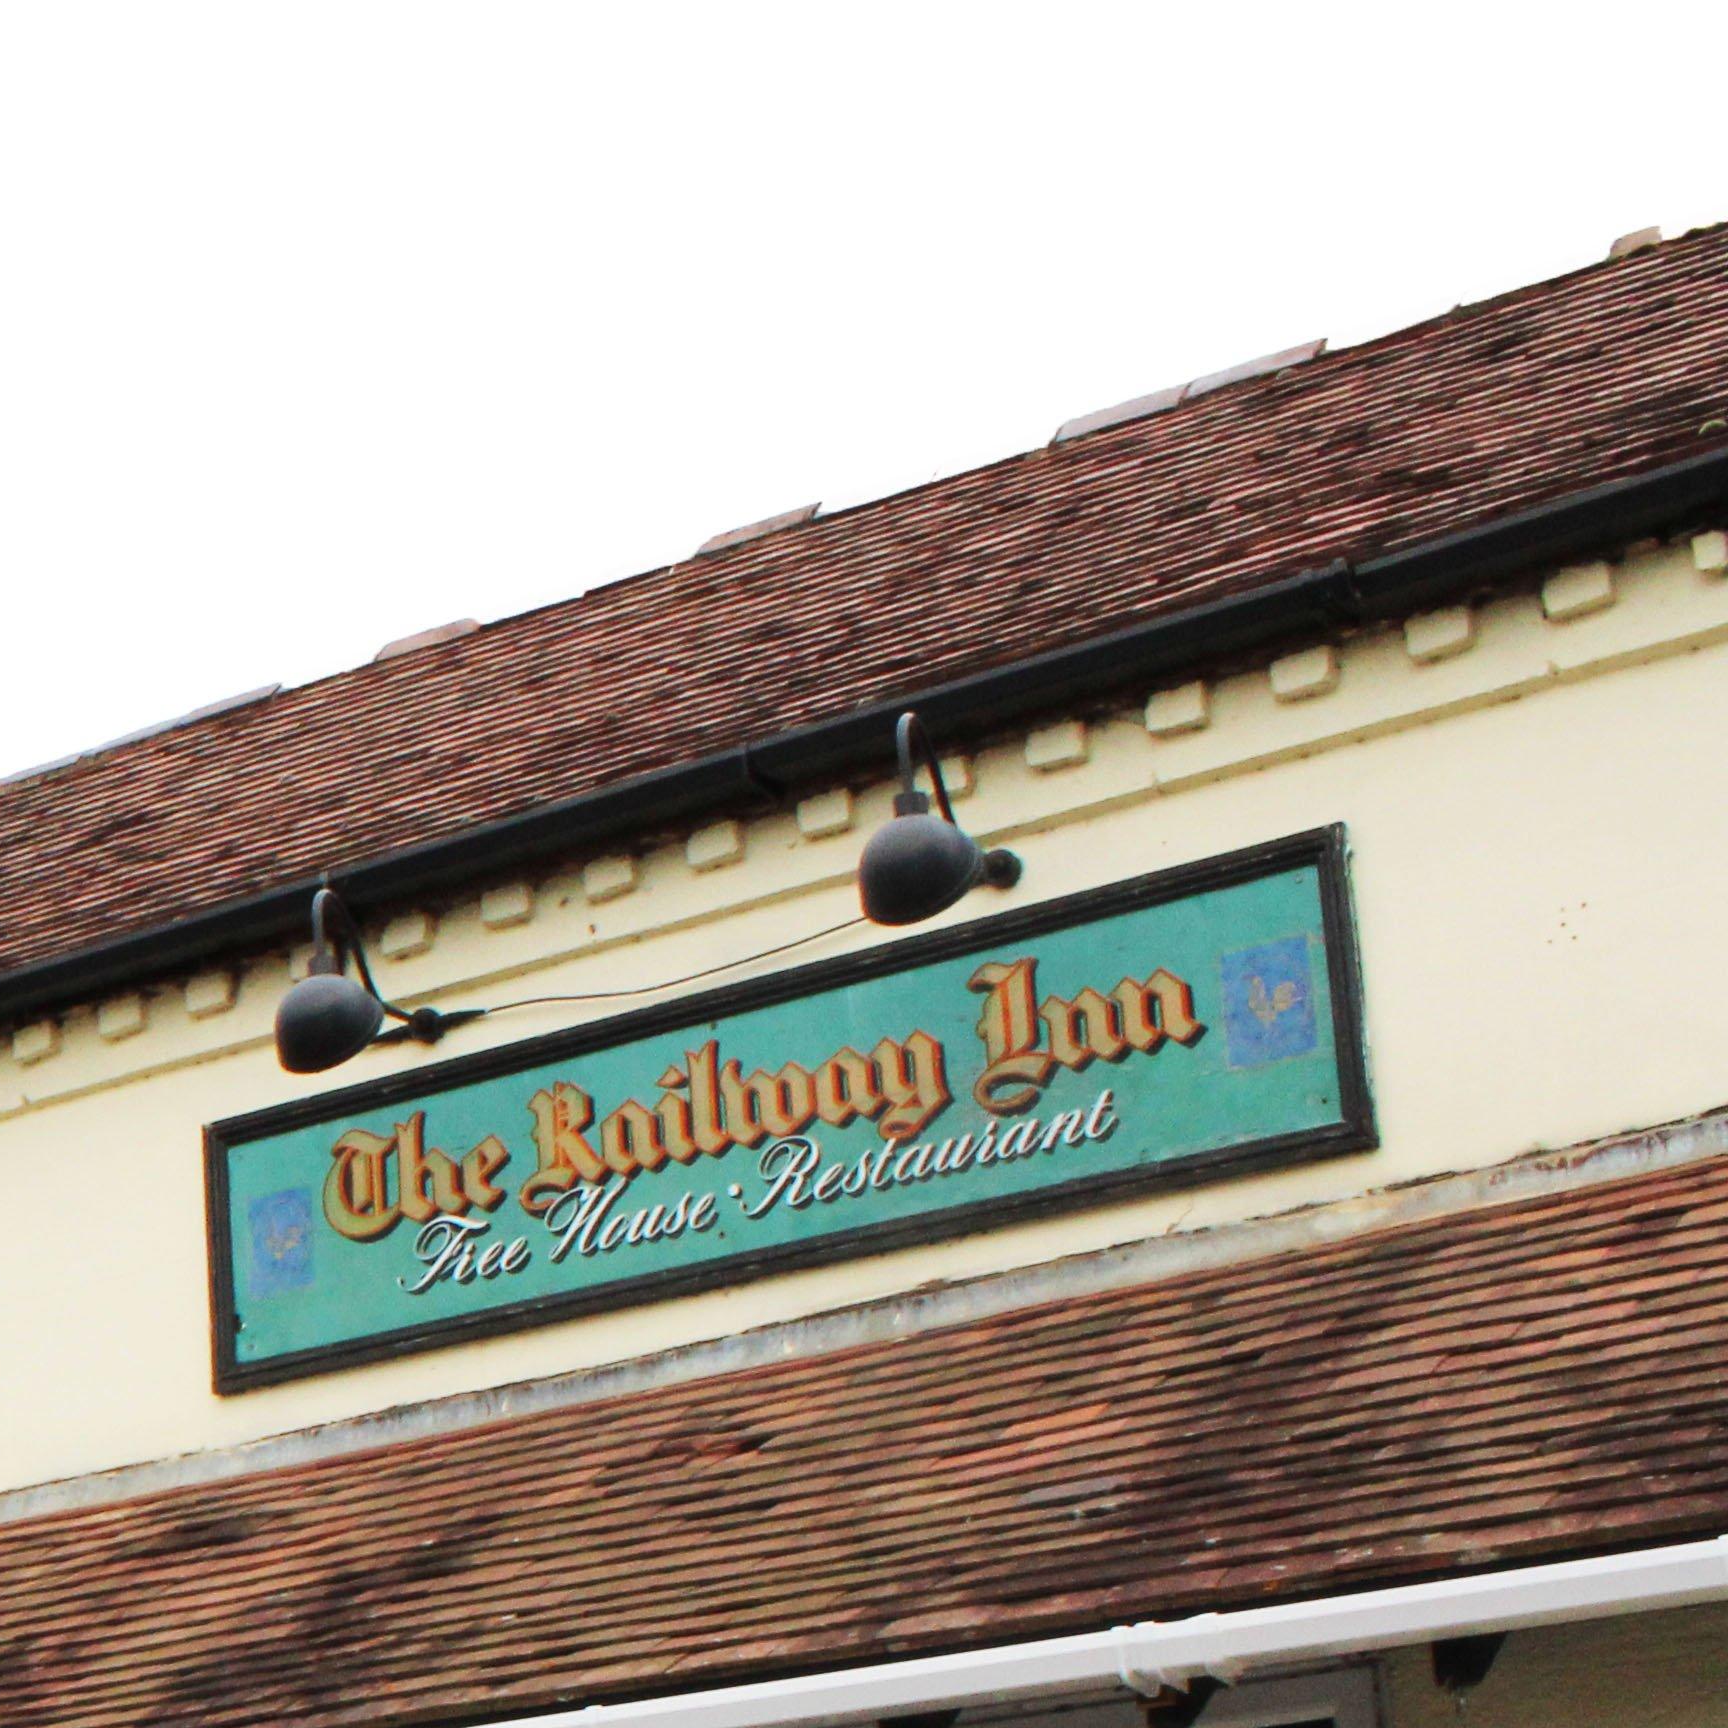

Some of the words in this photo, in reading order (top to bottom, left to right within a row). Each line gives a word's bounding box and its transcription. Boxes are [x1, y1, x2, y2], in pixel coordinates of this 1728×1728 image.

[323, 1110, 508, 1242] The
[520, 1028, 951, 1216] Railway
[965, 957, 1202, 1113] Inn
[397, 1213, 532, 1294] Free
[543, 1176, 717, 1264] House
[744, 1088, 1115, 1220] Restaurant
